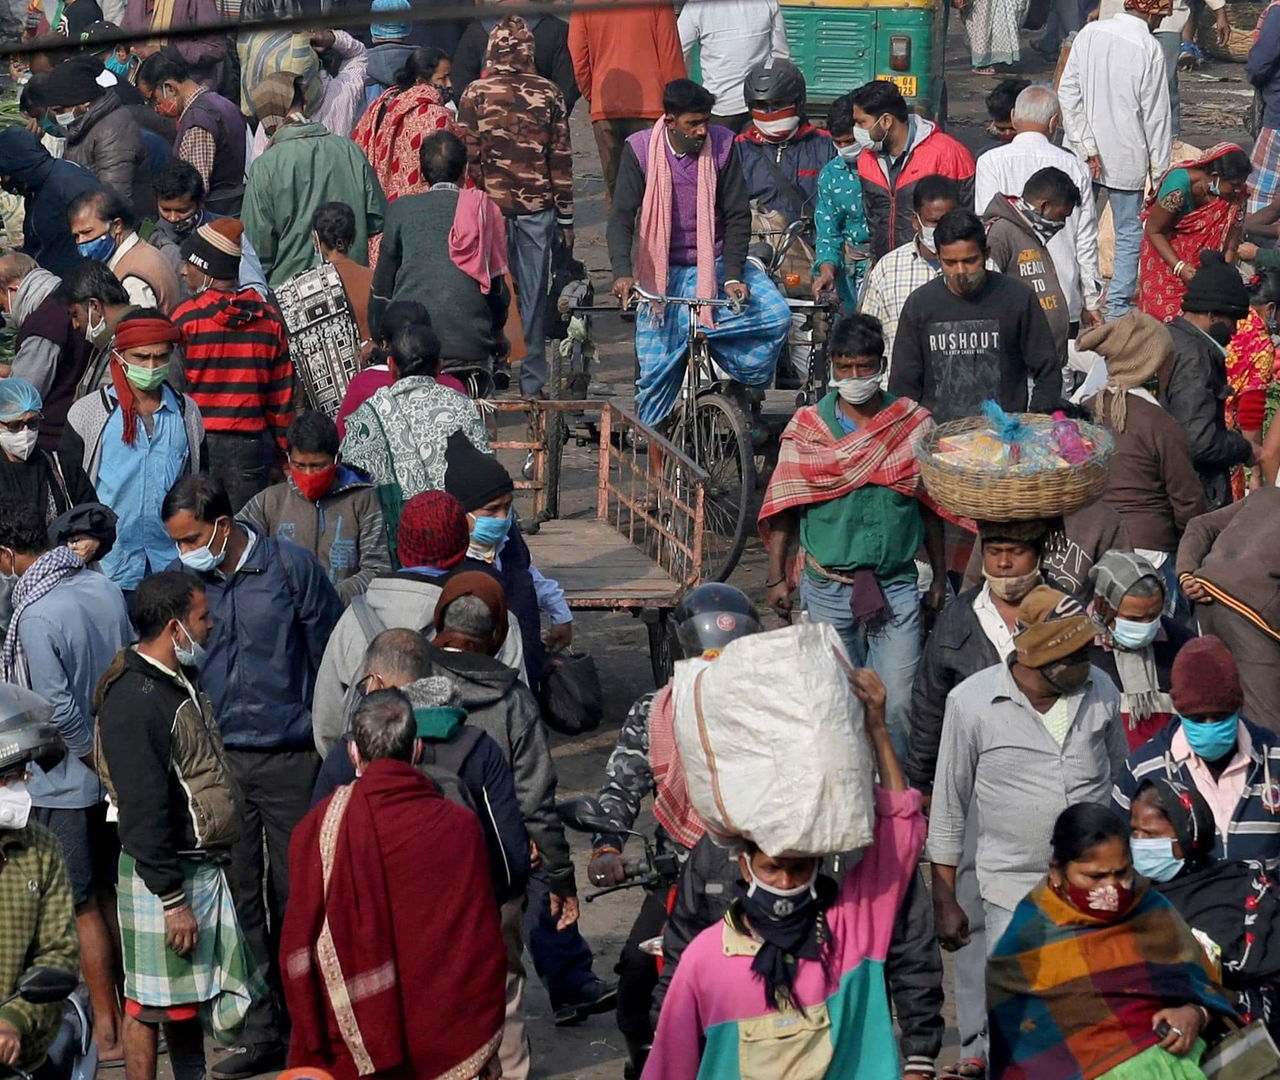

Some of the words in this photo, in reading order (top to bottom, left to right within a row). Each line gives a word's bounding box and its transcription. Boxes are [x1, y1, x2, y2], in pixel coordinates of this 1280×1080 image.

[188, 253, 210, 270] NIKE
[1019, 261, 1046, 278] READY
[1031, 278, 1047, 294] TO
[1038, 295, 1059, 311] ACE
[929, 331, 1000, 352] RUSHOUT
